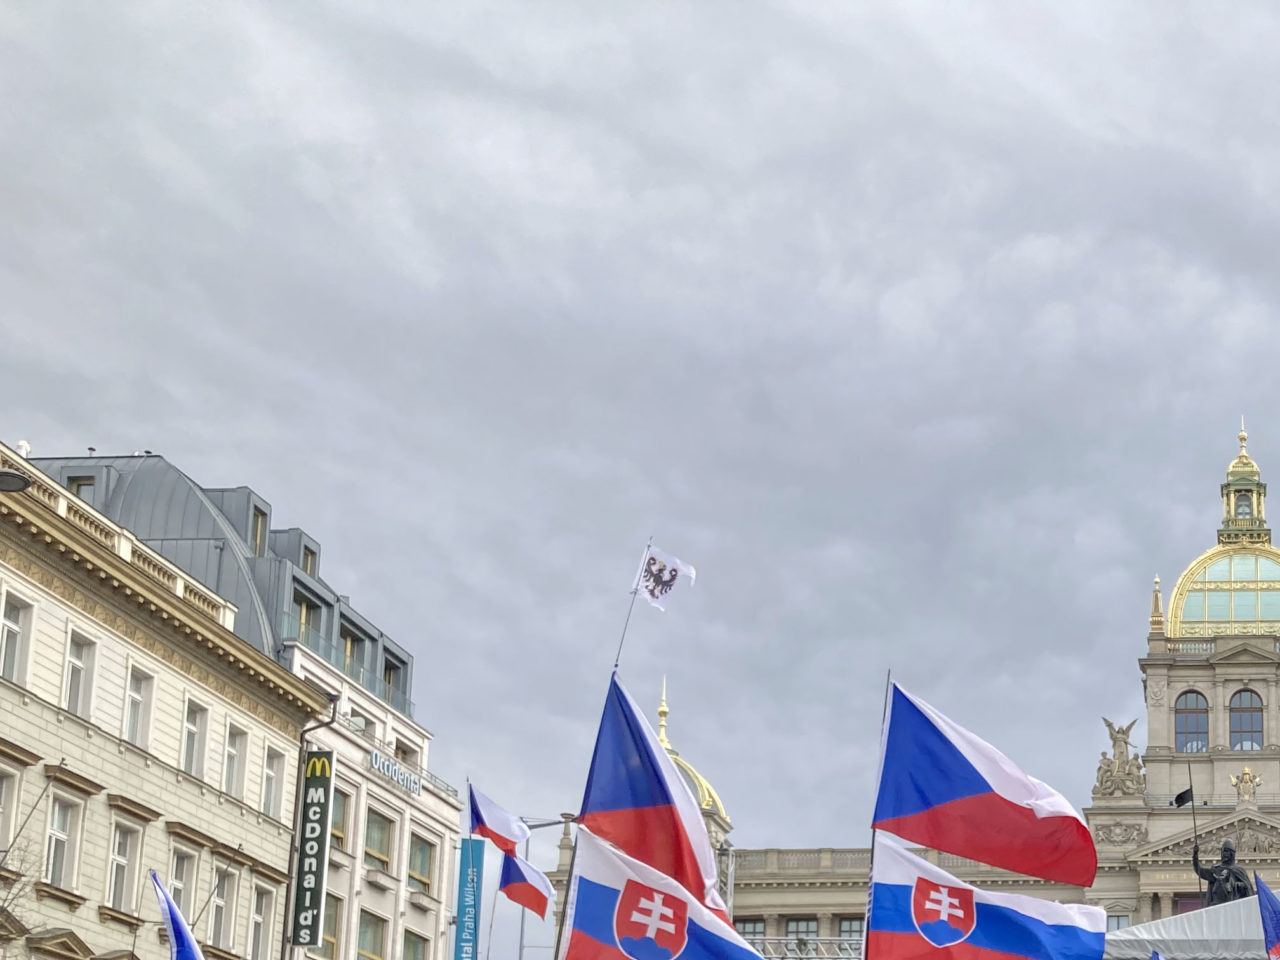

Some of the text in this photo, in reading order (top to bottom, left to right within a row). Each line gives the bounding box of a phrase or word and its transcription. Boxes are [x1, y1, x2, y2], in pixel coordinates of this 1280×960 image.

[372, 751, 422, 796] Occidental
[299, 787, 325, 944] McDonald's
[463, 867, 478, 905] Wilson
[462, 908, 475, 939] Praha
